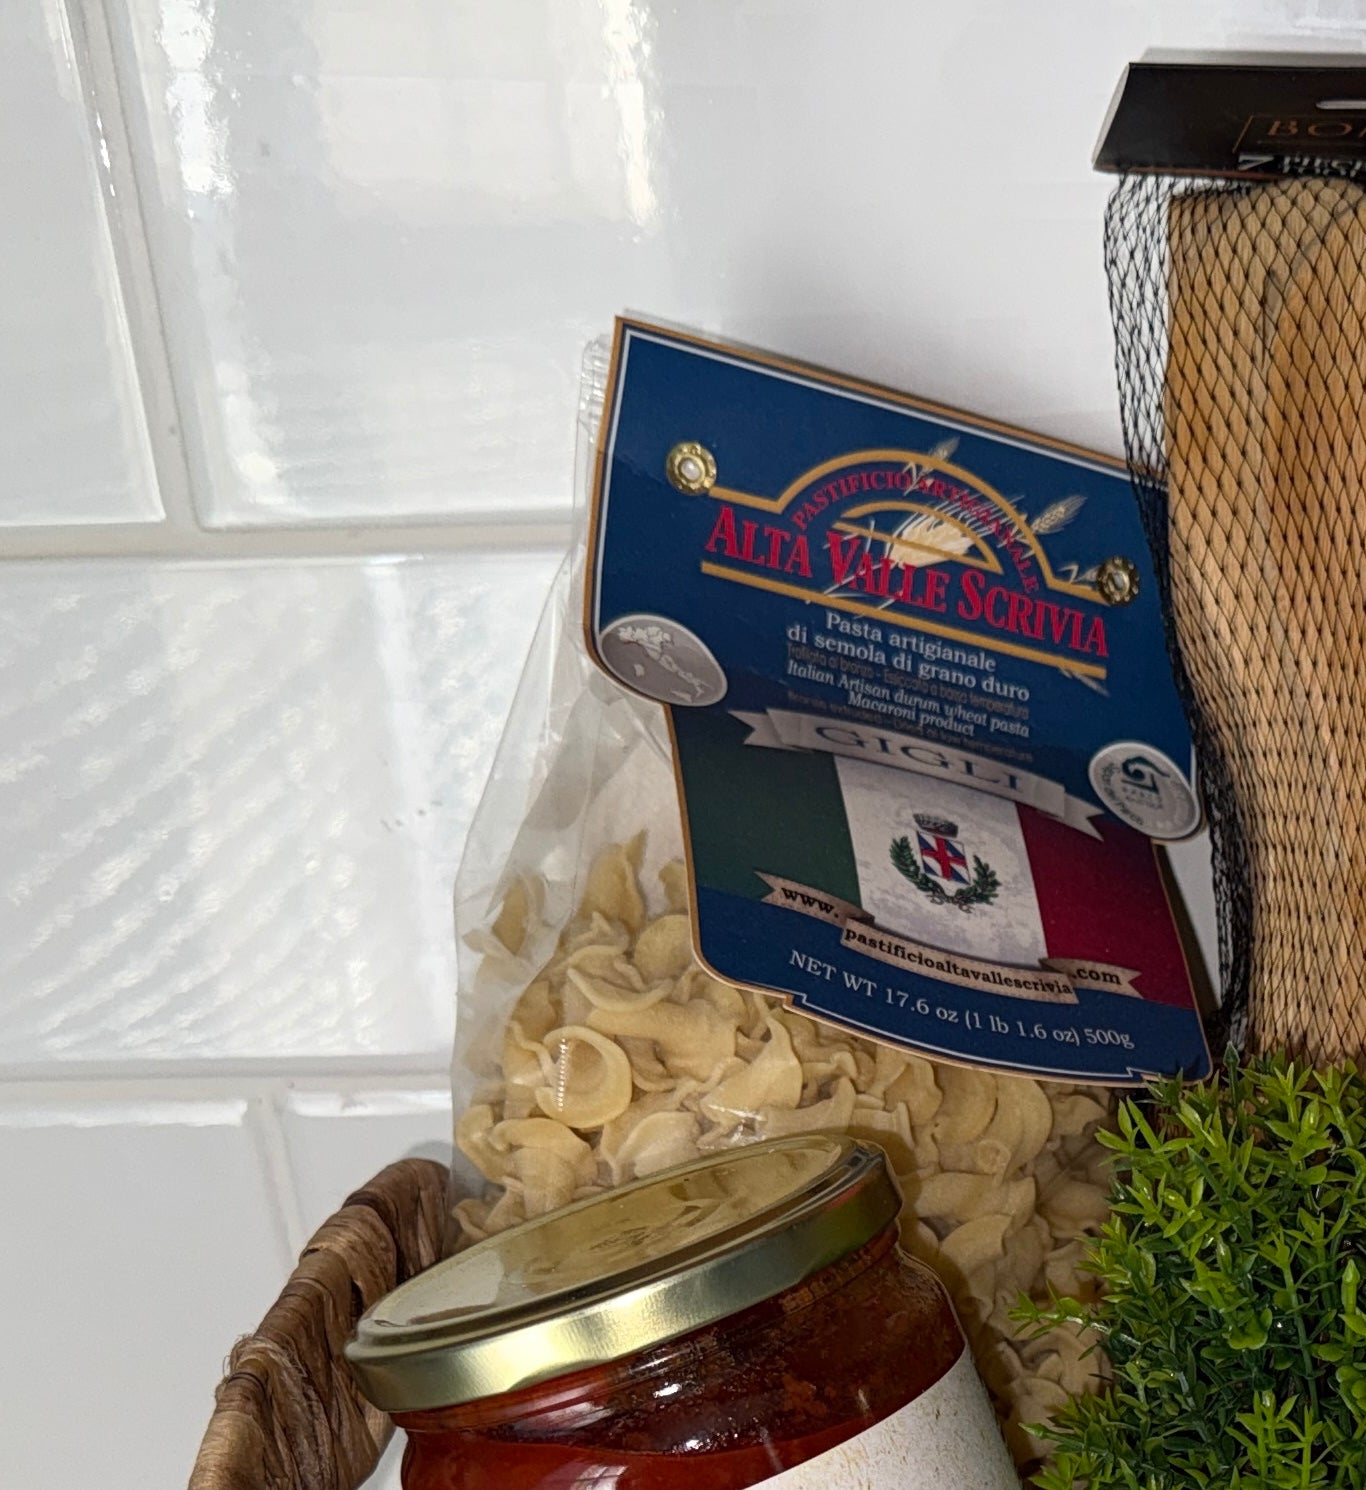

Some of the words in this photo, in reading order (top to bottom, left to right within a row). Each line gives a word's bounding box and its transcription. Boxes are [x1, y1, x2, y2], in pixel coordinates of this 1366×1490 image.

[791, 470, 912, 531] PASTIFICIO
[704, 506, 814, 579] ALTA
[826, 531, 950, 613] VALLE
[958, 568, 1111, 657] SCRIVIA
[786, 624, 809, 645] di
[814, 634, 887, 666] semola
[892, 653, 913, 673] di
[917, 661, 977, 689] grano
[981, 672, 1031, 702] duro
[826, 611, 883, 644] Pasta
[888, 633, 997, 673] artigianale
[787, 659, 835, 686] Italian
[838, 673, 890, 700] Artisan
[893, 690, 941, 714] durum
[944, 702, 988, 728] wheat
[989, 713, 1030, 739] pasta
[848, 690, 917, 722] Macaroni
[919, 712, 976, 737] product
[816, 726, 1019, 790] GIGLI
[780, 886, 841, 920] www.
[1071, 965, 1122, 986] .com
[789, 948, 835, 981] NET
[842, 974, 878, 998] WT
[885, 987, 930, 1016] 17.6
[935, 1008, 960, 1023] oz
[964, 1010, 984, 1033] (1
[989, 1015, 1010, 1036] lb
[1016, 1021, 1048, 1040] 1.6
[1052, 1025, 1080, 1047] oz)
[1084, 1028, 1135, 1051] 500g
